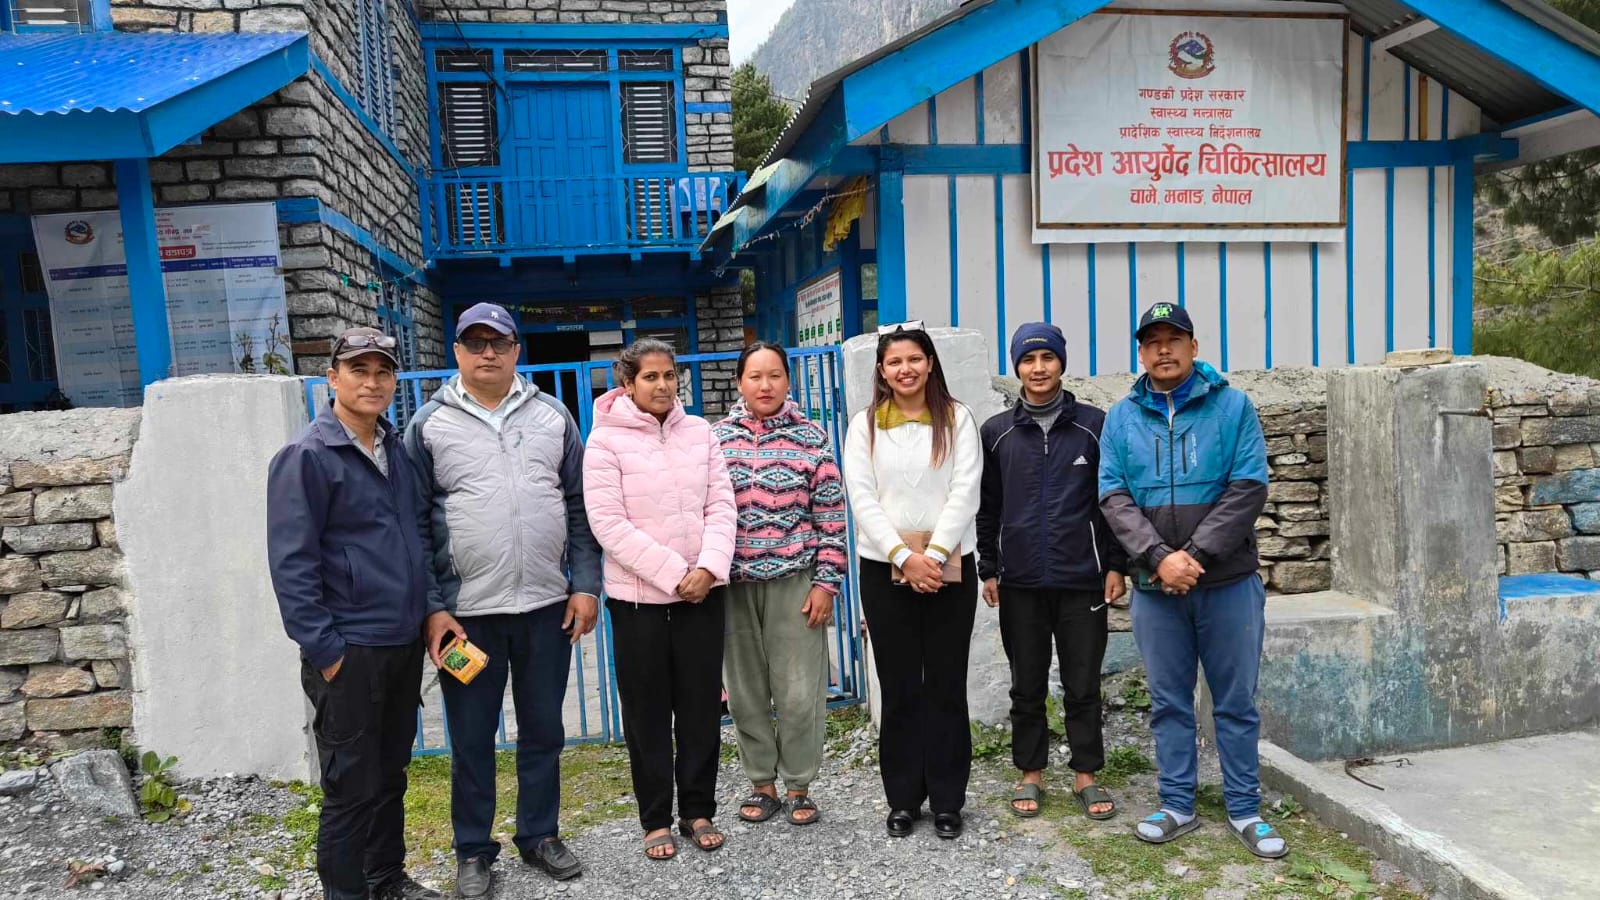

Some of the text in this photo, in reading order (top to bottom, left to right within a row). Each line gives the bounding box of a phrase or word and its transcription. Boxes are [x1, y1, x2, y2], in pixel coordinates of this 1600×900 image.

[1138, 86, 1246, 102] गण्डकी प्रदेश सरकार
[1150, 107, 1234, 120] स्वास्थ्य मन्त्रालय
[1119, 123, 1161, 139] प्रादेशिक
[1166, 127, 1205, 138] स्वास्थ्य
[1047, 142, 1327, 182] प्रदेश आयुर्वेद चिकित्सालय
[1212, 184, 1253, 205] नेपाल
